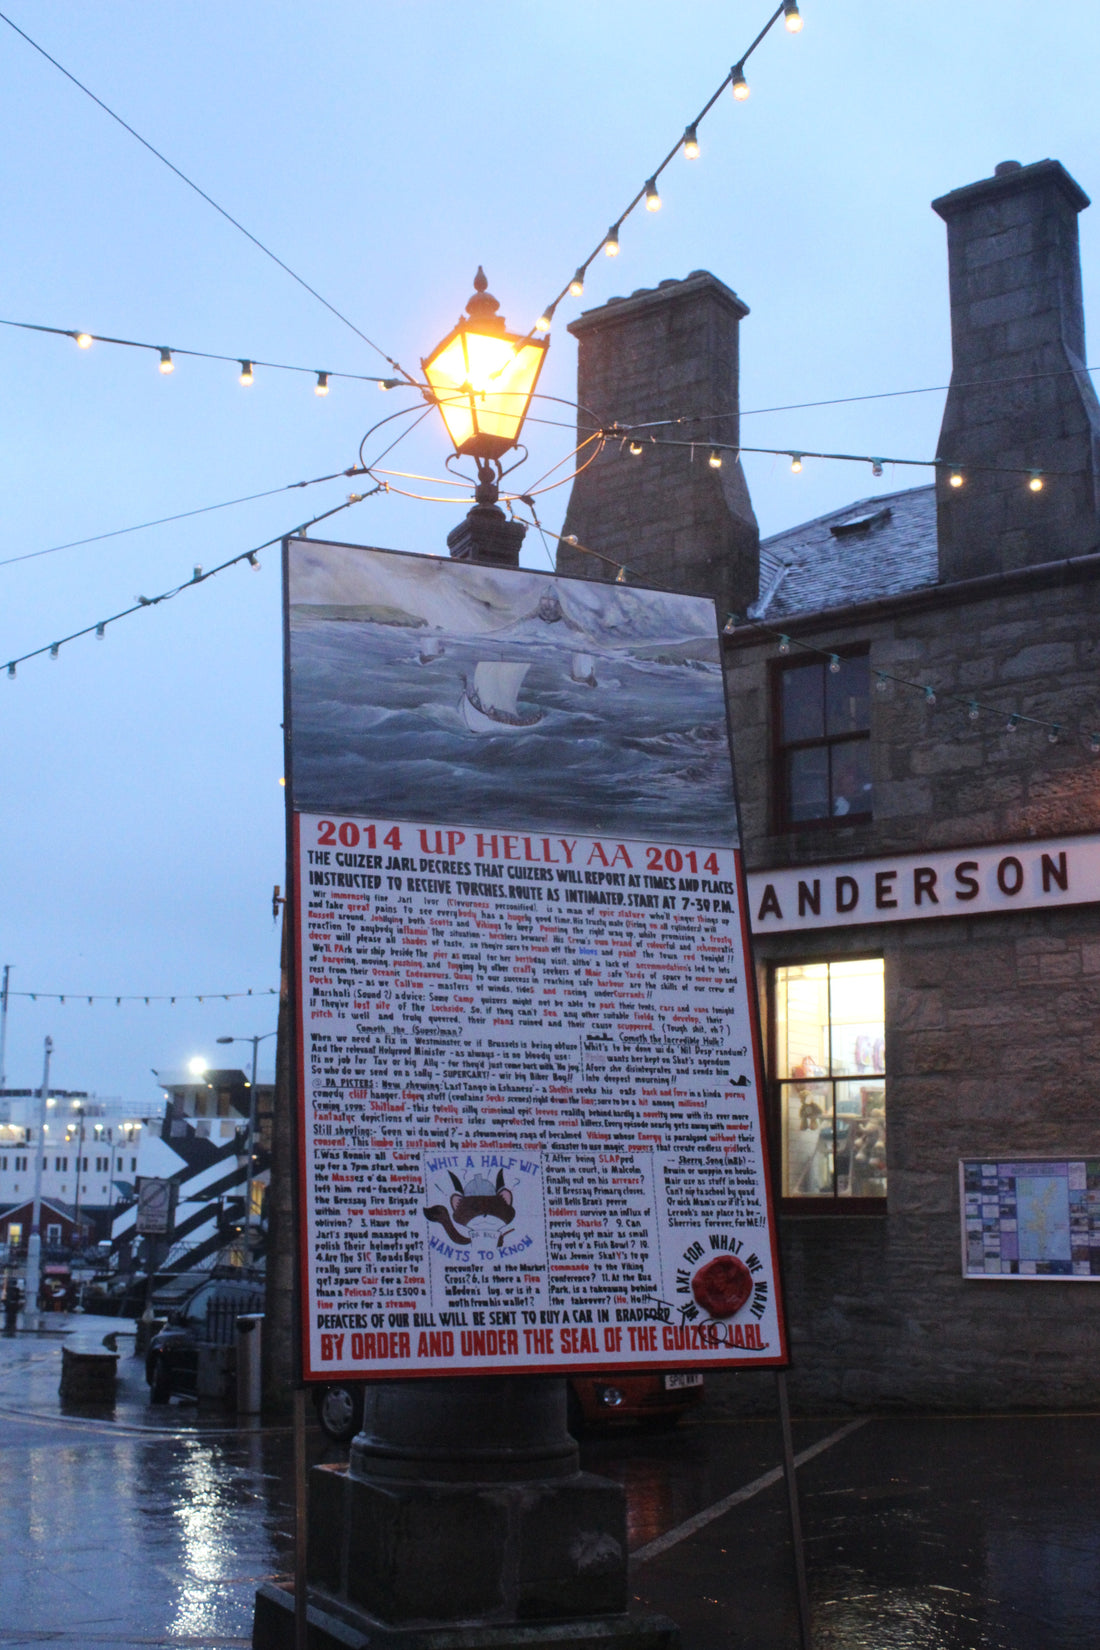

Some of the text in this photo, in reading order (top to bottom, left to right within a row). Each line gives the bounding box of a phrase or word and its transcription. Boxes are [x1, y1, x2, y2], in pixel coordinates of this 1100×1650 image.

[317, 820, 720, 876] 2014 UP HELLY AA 2014
[307, 849, 734, 895] THE GUIZER JARL DECREES THAT GUIZERS WILL REPORT AT TIMES AND PLACES
[308, 870, 382, 889] INSTRUCTED
[386, 875, 402, 891] TO
[406, 877, 452, 894] RECEIVE
[508, 884, 543, 901] ROUTE
[546, 887, 560, 902] AS
[627, 893, 659, 909] START
[662, 895, 676, 910] AT
[681, 896, 711, 912] 7-30
[712, 899, 735, 914] P.M.
[757, 851, 1069, 920] ANDERSON
[311, 1009, 332, 1019] pitch
[337, 1008, 345, 1019] is
[350, 1011, 370, 1020] well
[378, 1012, 394, 1021] and
[402, 1013, 422, 1024] truly
[467, 1015, 486, 1024] their
[492, 1016, 514, 1026] plans
[518, 1018, 543, 1026] ruined
[547, 1019, 562, 1027] and
[567, 1020, 585, 1028] their
[356, 1023, 385, 1033] Cometh
[393, 1025, 405, 1033] the
[618, 1031, 648, 1043] Cometh
[649, 1033, 662, 1043] the
[663, 1034, 700, 1045] Incredible
[606, 1054, 629, 1063] wants
[630, 1054, 643, 1063] her
[643, 1055, 660, 1065] kept
[609, 1064, 622, 1072] she
[625, 1064, 671, 1074] disintegrates
[675, 1067, 690, 1075] and
[692, 1067, 713, 1076] sends
[715, 1067, 729, 1076] him
[603, 1074, 631, 1084] deepest
[426, 1153, 540, 1176] WHIT A HALF WIT
[314, 1195, 330, 1204] the
[333, 1195, 367, 1206] Bressay
[388, 1196, 418, 1206] Brigade
[579, 1208, 607, 1217] survive
[619, 1207, 642, 1217] influx
[643, 1207, 651, 1216] of
[668, 1217, 701, 1228] Sherries
[734, 1217, 746, 1227] for
[343, 1230, 369, 1240] squad
[371, 1230, 407, 1240] managed
[410, 1230, 419, 1239] to
[549, 1230, 581, 1240] anybody
[582, 1229, 594, 1240] get
[628, 1229, 648, 1238] small
[314, 1239, 424, 1252] polish their helmets yet?
[428, 1234, 534, 1262] WANTS TO KNOW
[708, 1233, 744, 1255] WHAT
[681, 1240, 705, 1265] FOR
[315, 1264, 340, 1276] really
[343, 1266, 362, 1274] sure
[380, 1263, 408, 1274] easier
[409, 1263, 419, 1273] to
[444, 1263, 546, 1273] encounter at the Market
[745, 1252, 762, 1274] WE
[675, 1267, 692, 1294] AXE
[572, 1284, 580, 1294] is
[582, 1286, 587, 1294] a
[589, 1285, 628, 1295] takeaway
[630, 1283, 658, 1294] behind
[317, 1299, 416, 1311] fine price for a steamy
[748, 1280, 769, 1320] WANT
[316, 1306, 670, 1329] DEFACERS OF OUR BILL WILL BE SENT TO BUY A CAR IN BRADFORD
[320, 1333, 345, 1361] BY
[350, 1331, 411, 1360] ORDER
[417, 1330, 455, 1358] AND
[460, 1328, 519, 1357] UNDER
[522, 1328, 555, 1355] THE
[559, 1327, 600, 1354] SEAL
[603, 1326, 623, 1353] OF
[626, 1325, 658, 1352] THE
[661, 1322, 720, 1351] GUIZER
